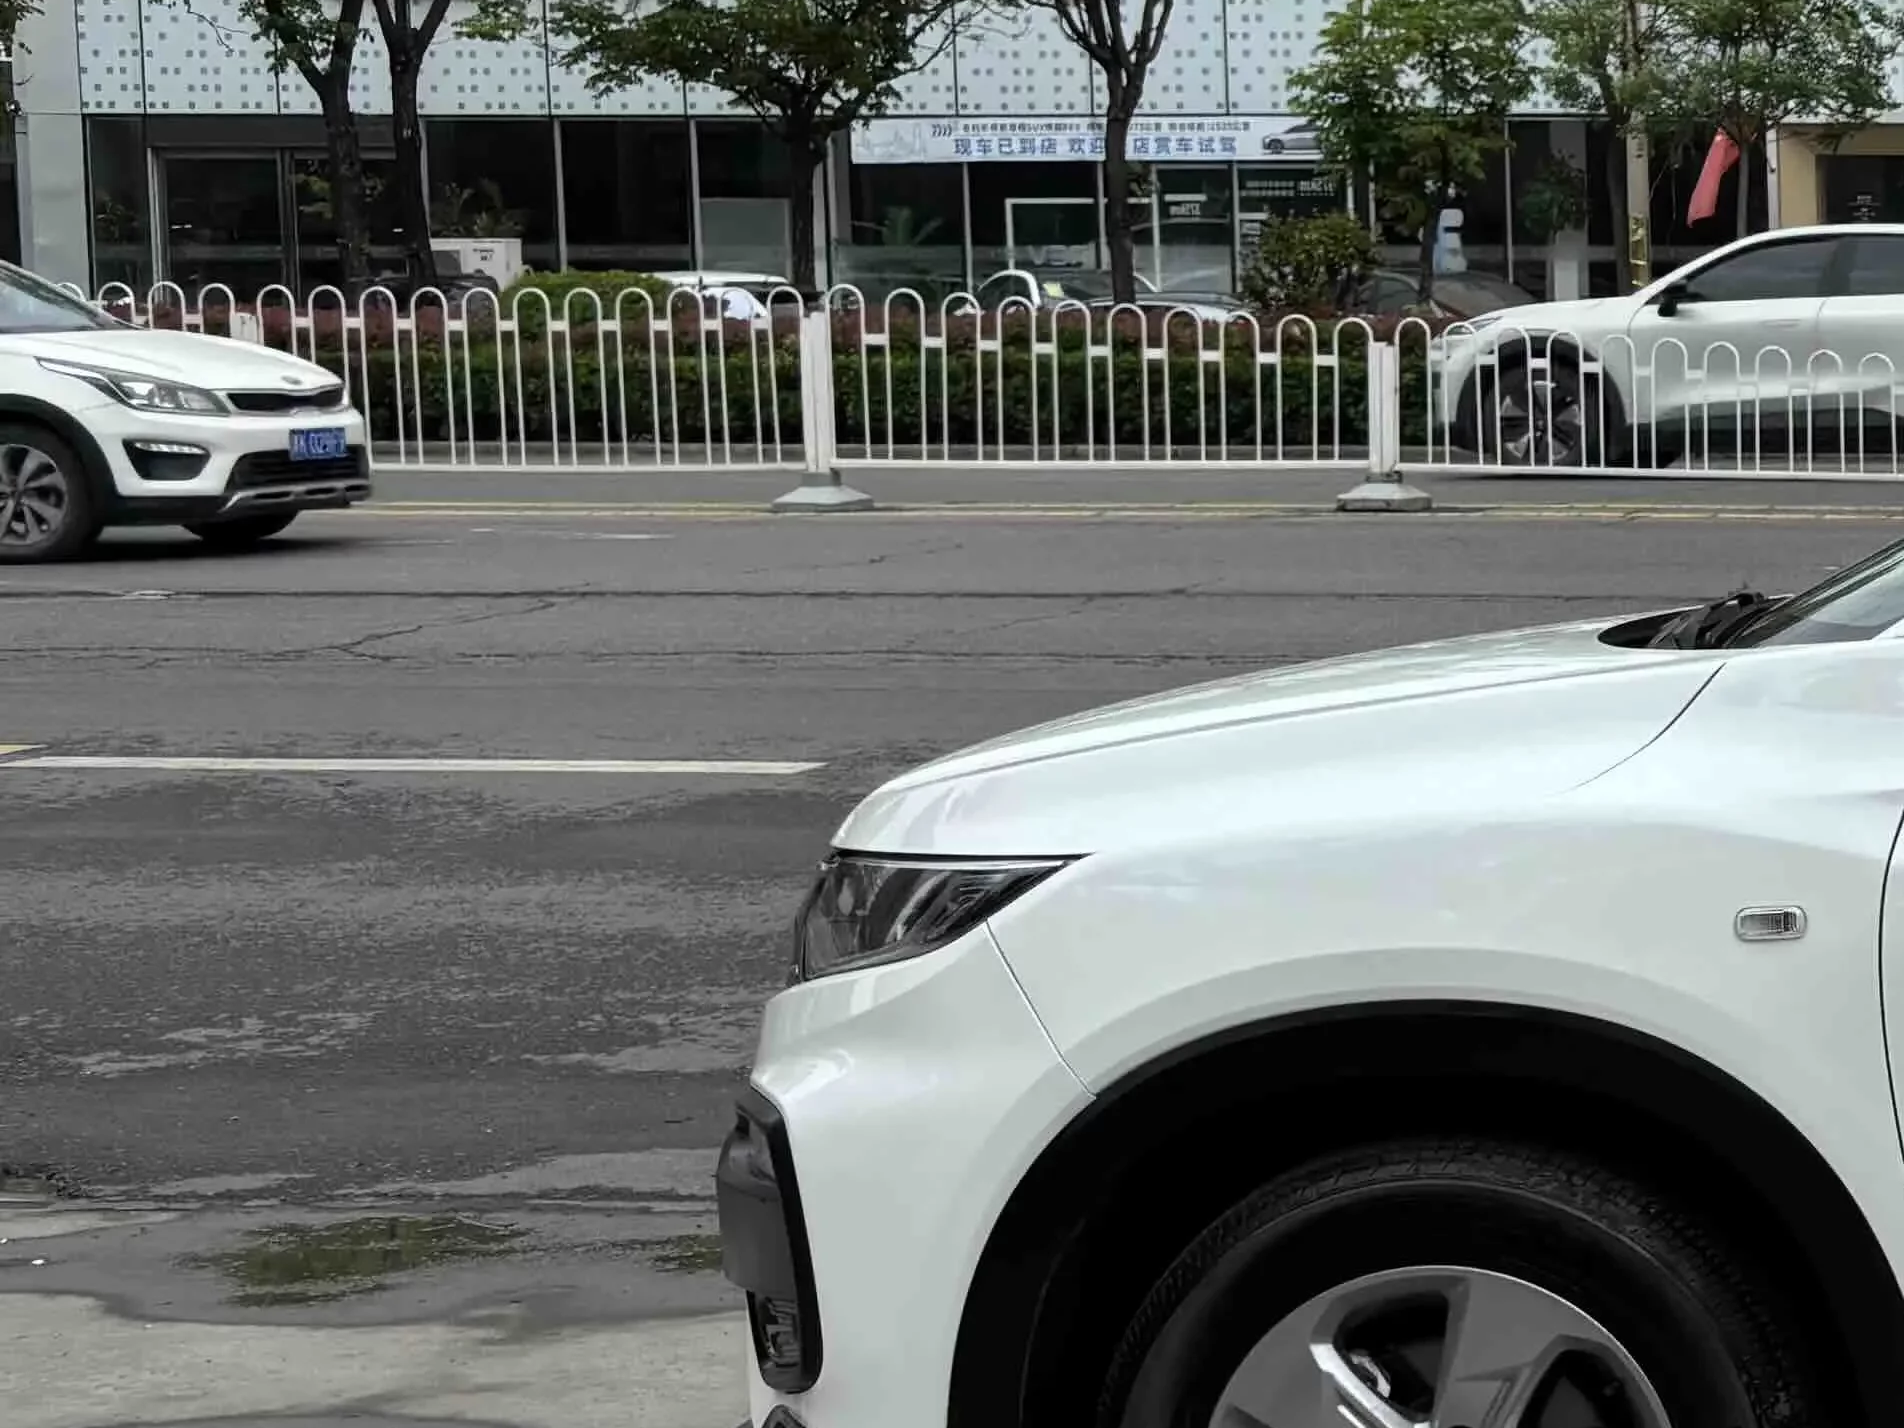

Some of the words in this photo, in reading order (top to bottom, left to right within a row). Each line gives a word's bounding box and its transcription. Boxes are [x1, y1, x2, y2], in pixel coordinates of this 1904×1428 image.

[953, 136, 1058, 156] 现车已到店
[1067, 135, 1238, 156] 欢迎店赏车试驾
